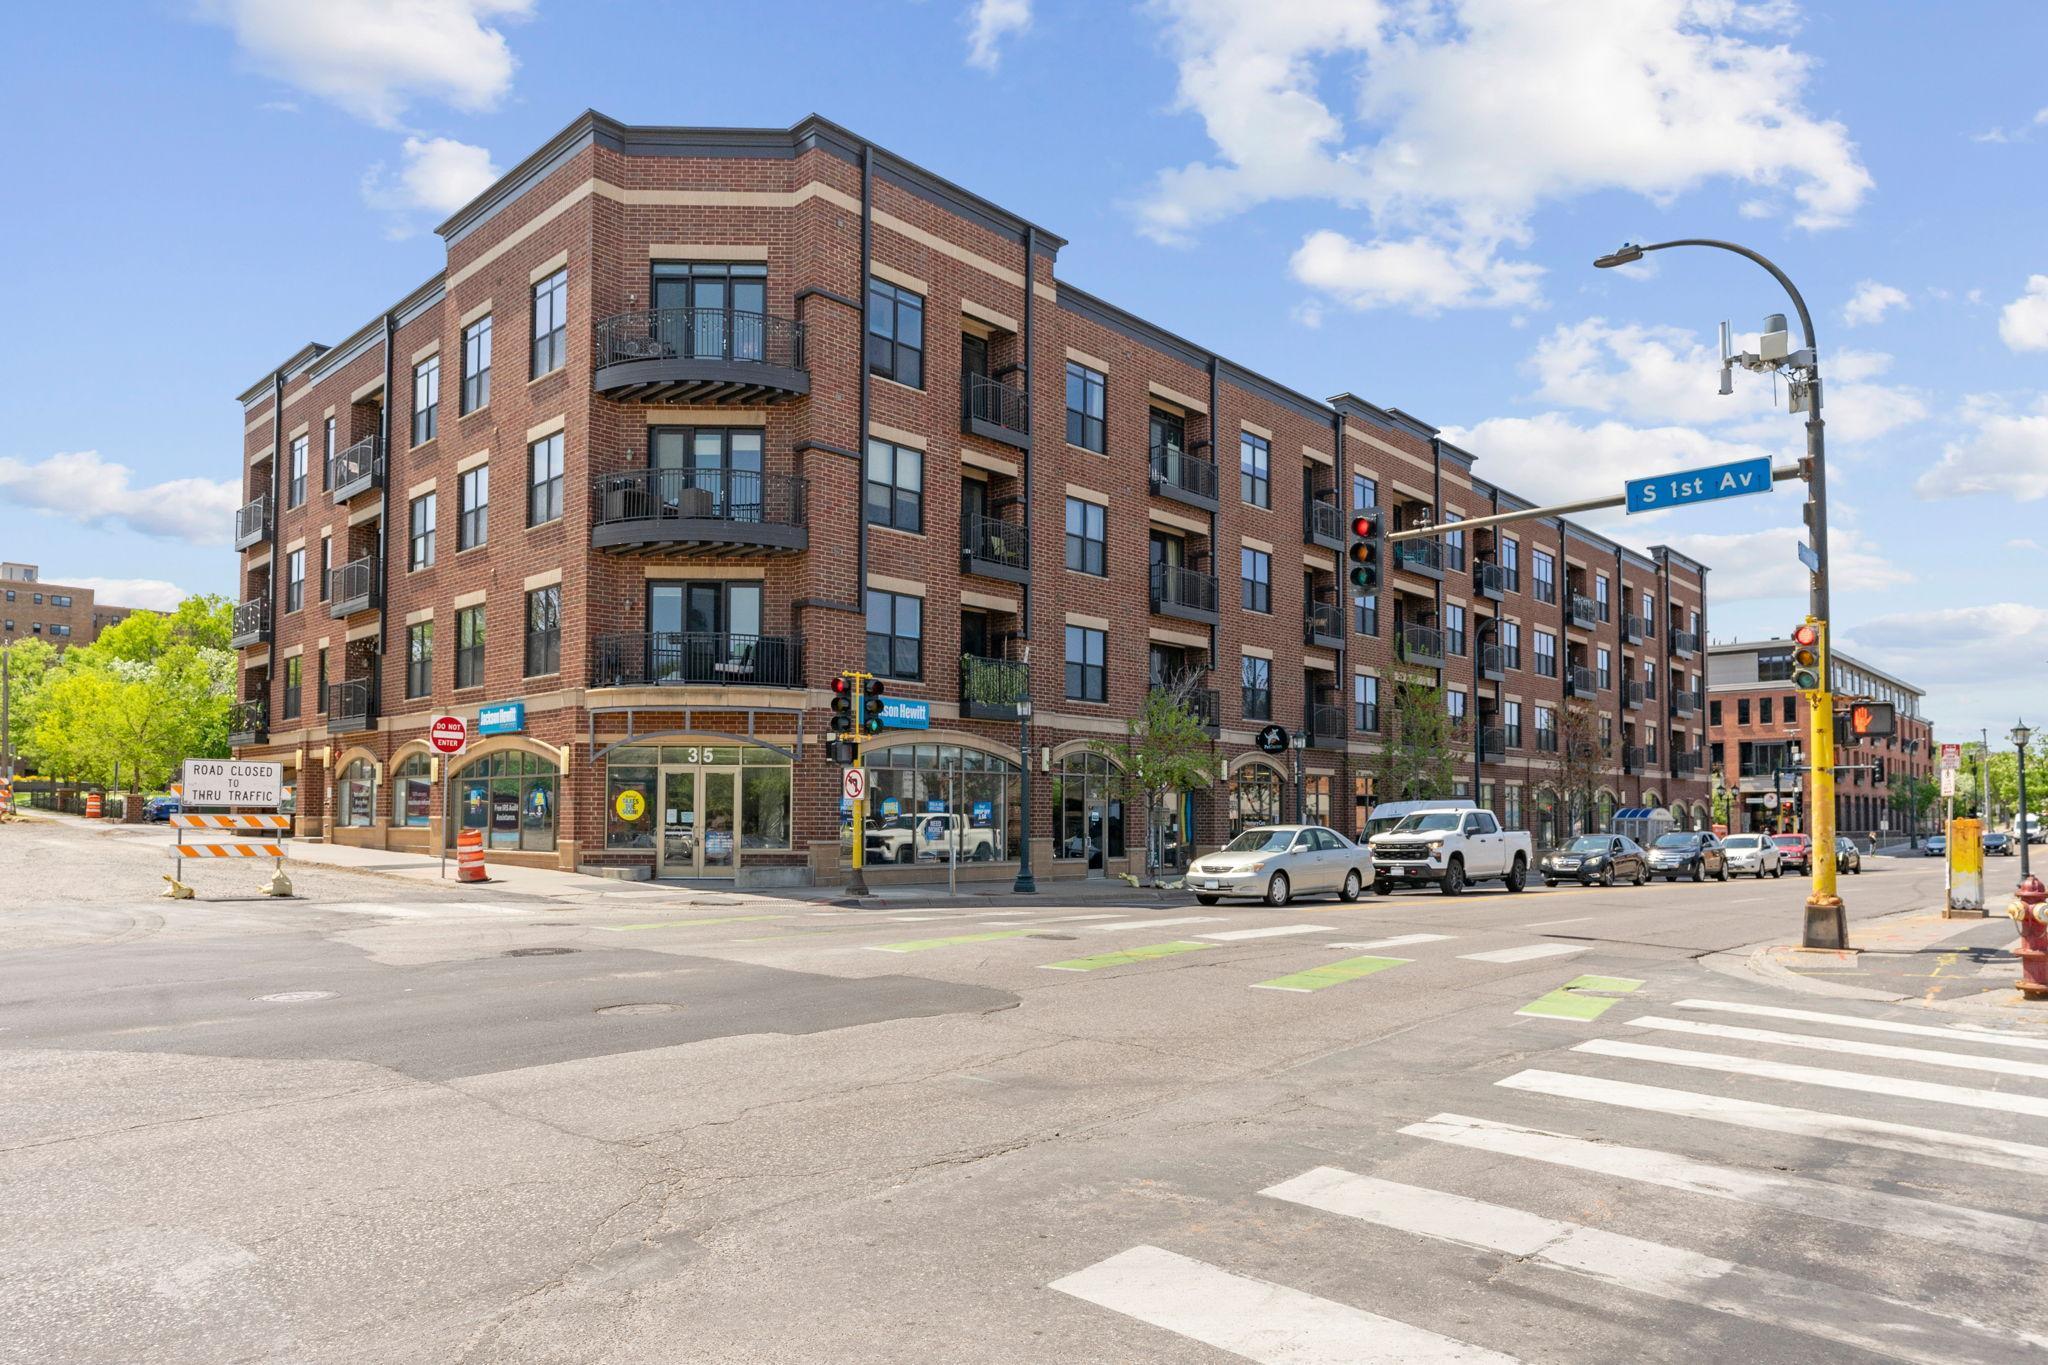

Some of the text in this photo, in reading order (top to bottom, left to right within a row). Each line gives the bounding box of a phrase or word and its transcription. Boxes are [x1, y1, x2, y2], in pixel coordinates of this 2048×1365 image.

[1643, 472, 1752, 503] S 1st Av
[900, 703, 926, 720] Hewitt
[437, 739, 458, 747] ENTER
[688, 747, 714, 763] 35
[193, 764, 273, 777] ROAD CLOSED
[228, 779, 239, 788] TO
[192, 789, 273, 801] THRU TRAFFIC
